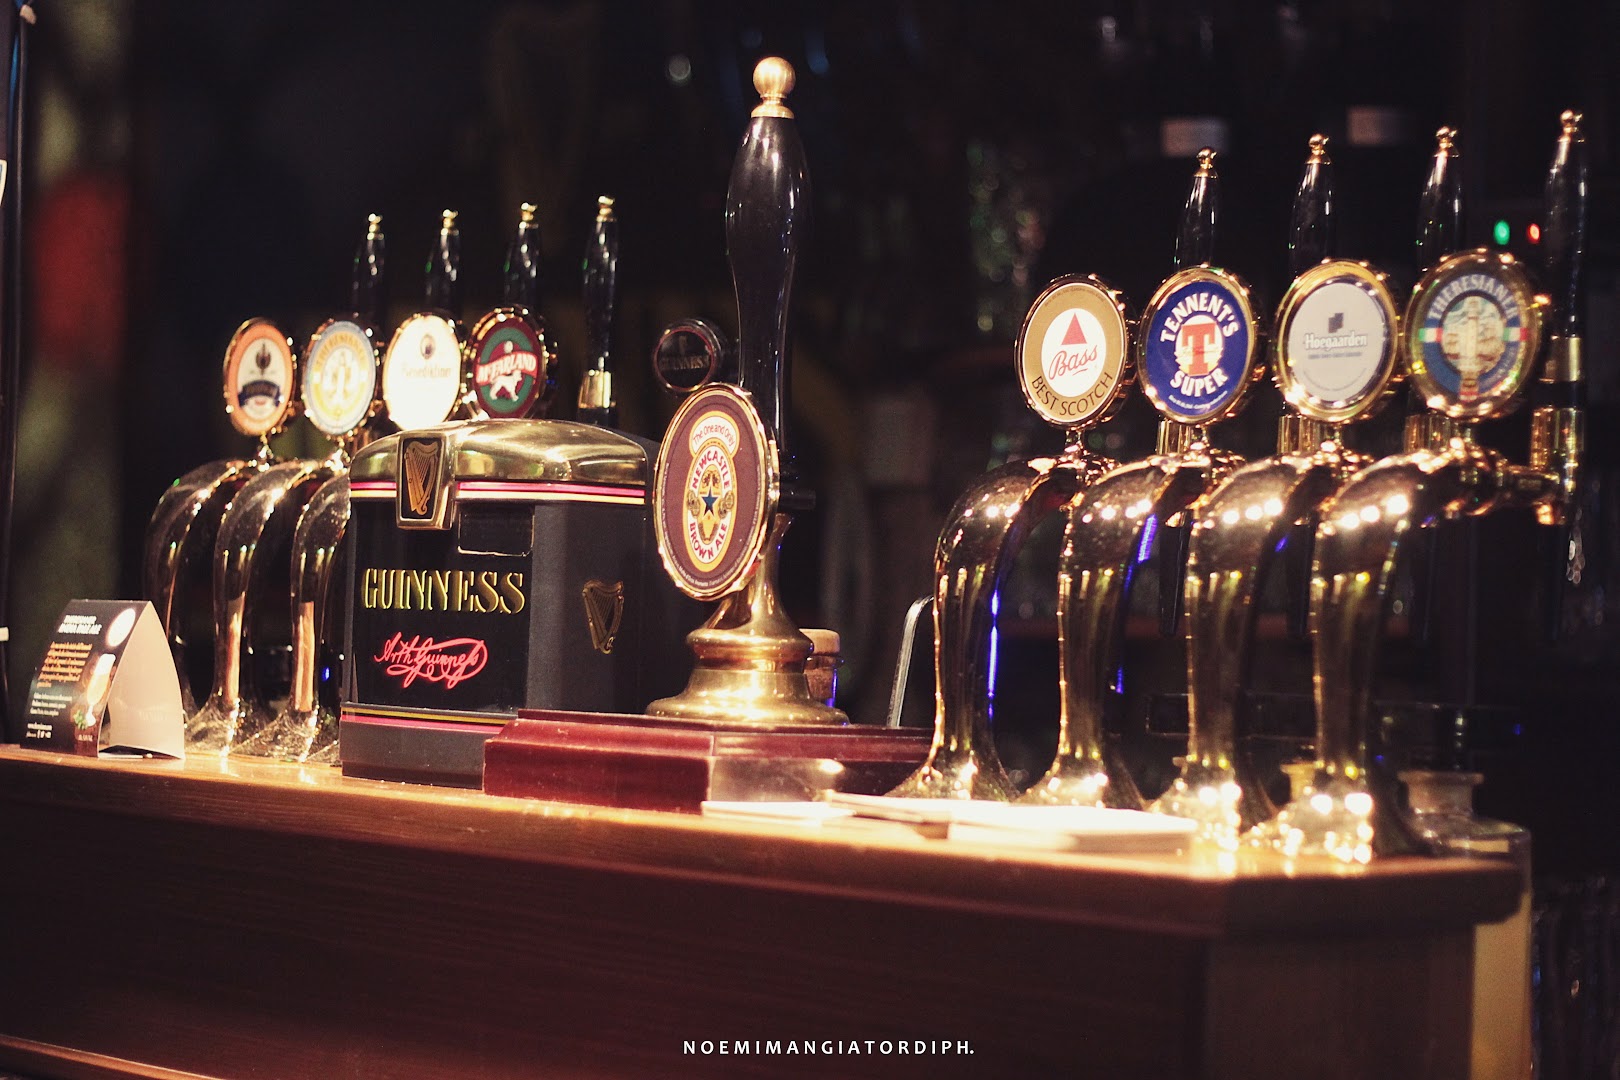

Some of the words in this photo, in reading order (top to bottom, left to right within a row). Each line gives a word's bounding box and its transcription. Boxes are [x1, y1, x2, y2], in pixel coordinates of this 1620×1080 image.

[1160, 292, 1239, 342] TENNENT'S
[1304, 330, 1368, 351] Hoegaarden
[1048, 344, 1098, 380] Bass
[1031, 375, 1059, 410] BEST
[1059, 371, 1114, 416] SCOTCH
[1169, 368, 1229, 397] SUPER
[693, 430, 704, 446] The
[691, 450, 731, 490] NEWCASTLE
[689, 521, 715, 560] BROWN
[715, 523, 728, 551] ALE
[361, 567, 526, 615] GUINNESS
